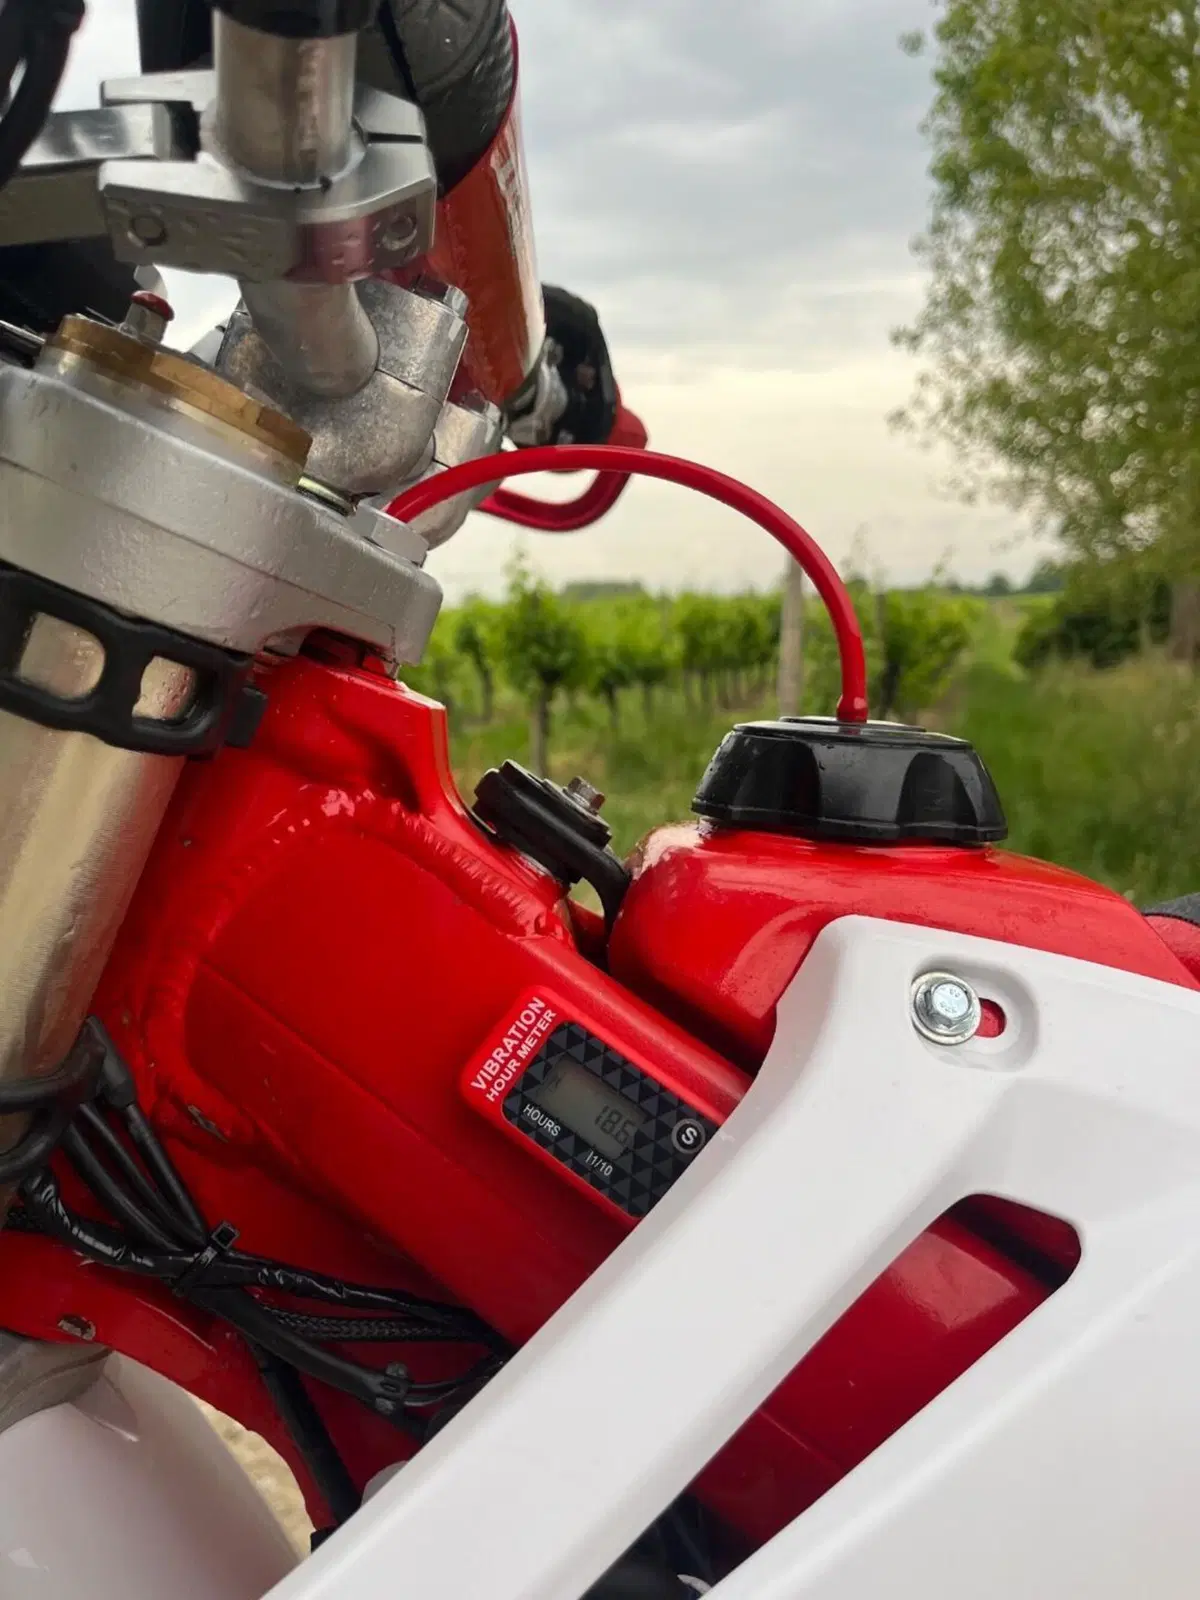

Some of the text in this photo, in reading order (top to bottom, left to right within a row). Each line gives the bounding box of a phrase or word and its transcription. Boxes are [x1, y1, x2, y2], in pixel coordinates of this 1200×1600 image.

[470, 996, 546, 1090] VIBRATION
[485, 1009, 557, 1102] HOUR METER
[522, 1103, 562, 1138] HOURS
[681, 1126, 698, 1146] S
